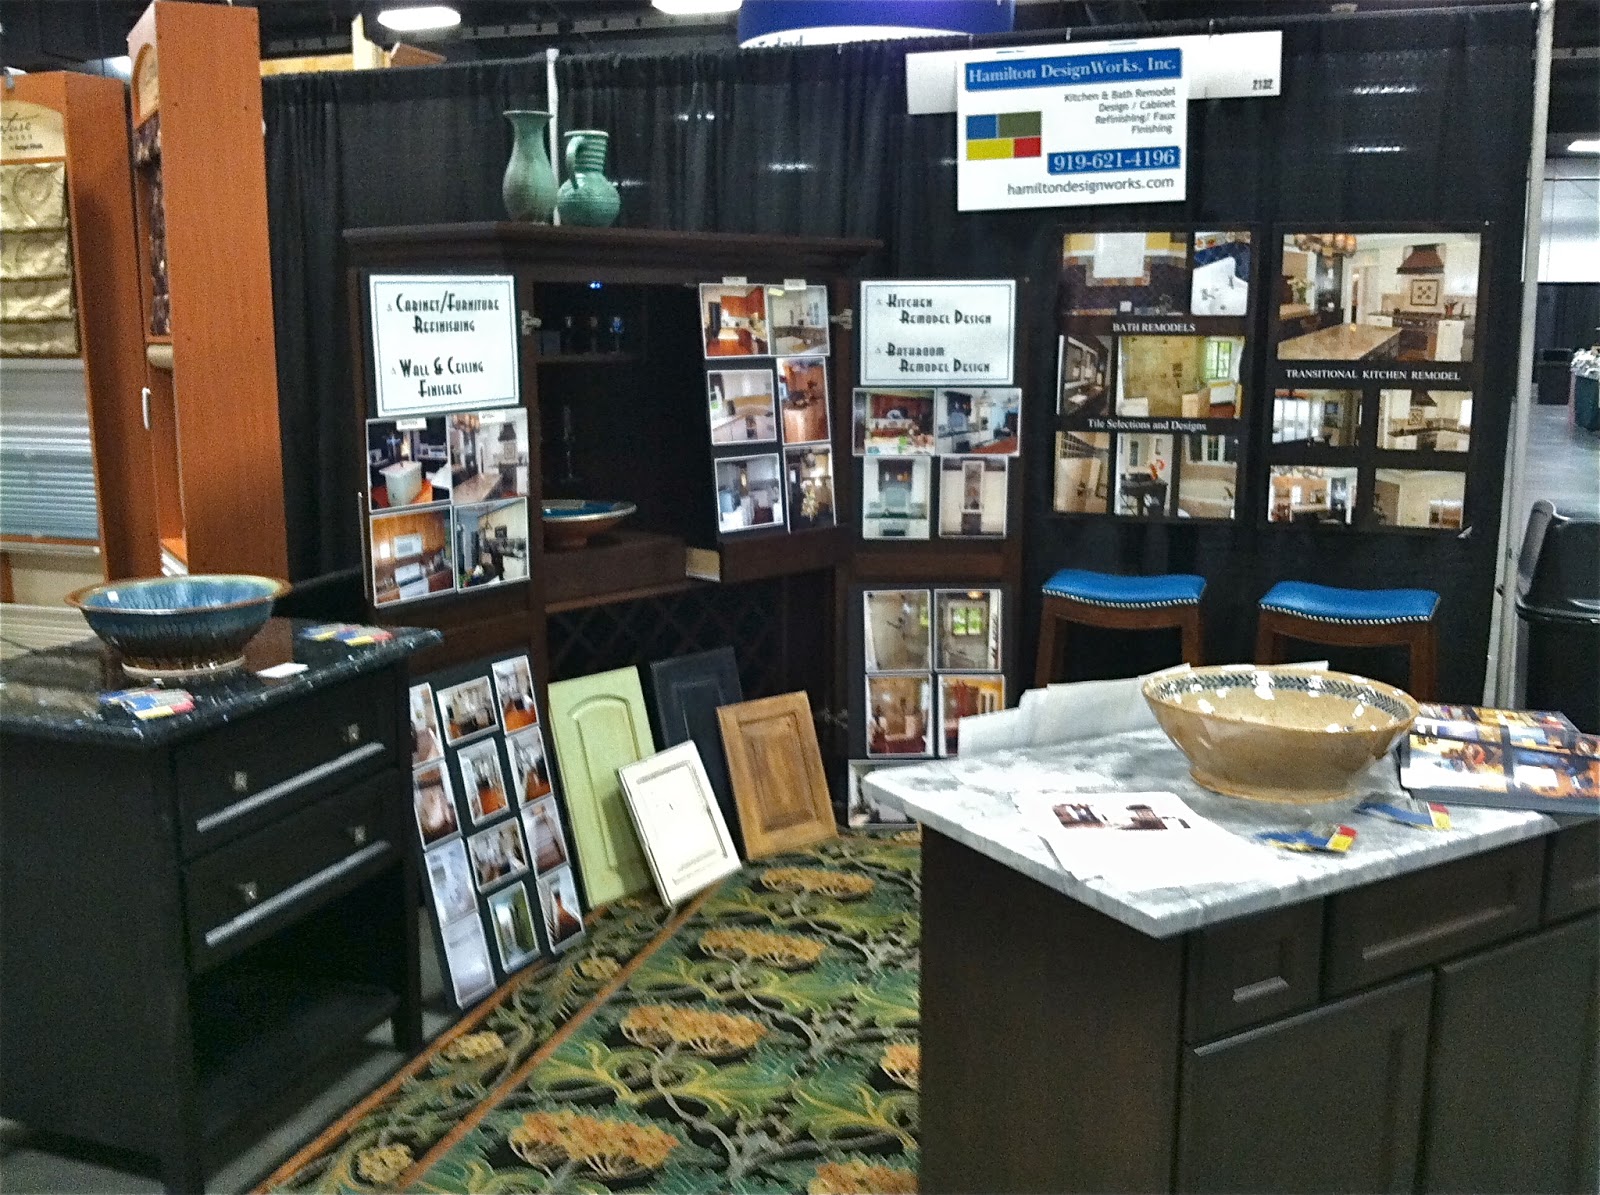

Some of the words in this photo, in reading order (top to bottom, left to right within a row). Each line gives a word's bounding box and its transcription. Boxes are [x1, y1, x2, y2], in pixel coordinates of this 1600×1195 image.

[968, 67, 1036, 83] Hamilton
[1147, 58, 1176, 71] Inc.
[1064, 92, 1099, 102] Kitchen
[1101, 91, 1110, 100] &
[1111, 90, 1133, 100] Bath
[1135, 87, 1176, 98] Remodel
[1098, 102, 1129, 113] Design
[1139, 99, 1176, 110] Cabinet
[1153, 111, 1176, 121] Faux
[1131, 124, 1173, 135] Finishing
[1053, 149, 1176, 171] 919-621-4196
[1007, 177, 1174, 195] hamiltondesignworks.com
[1112, 323, 1140, 332] BATH
[1141, 323, 1196, 332] REMODELS
[433, 356, 444, 375] &
[1285, 369, 1358, 379] TRANSITIONAL
[1362, 370, 1407, 380] KITCHEN
[1411, 371, 1461, 381] REMODEL
[1088, 419, 1105, 429] Tile
[1106, 419, 1151, 430] Selections
[1152, 420, 1169, 430] and
[1171, 421, 1207, 432] Designs
